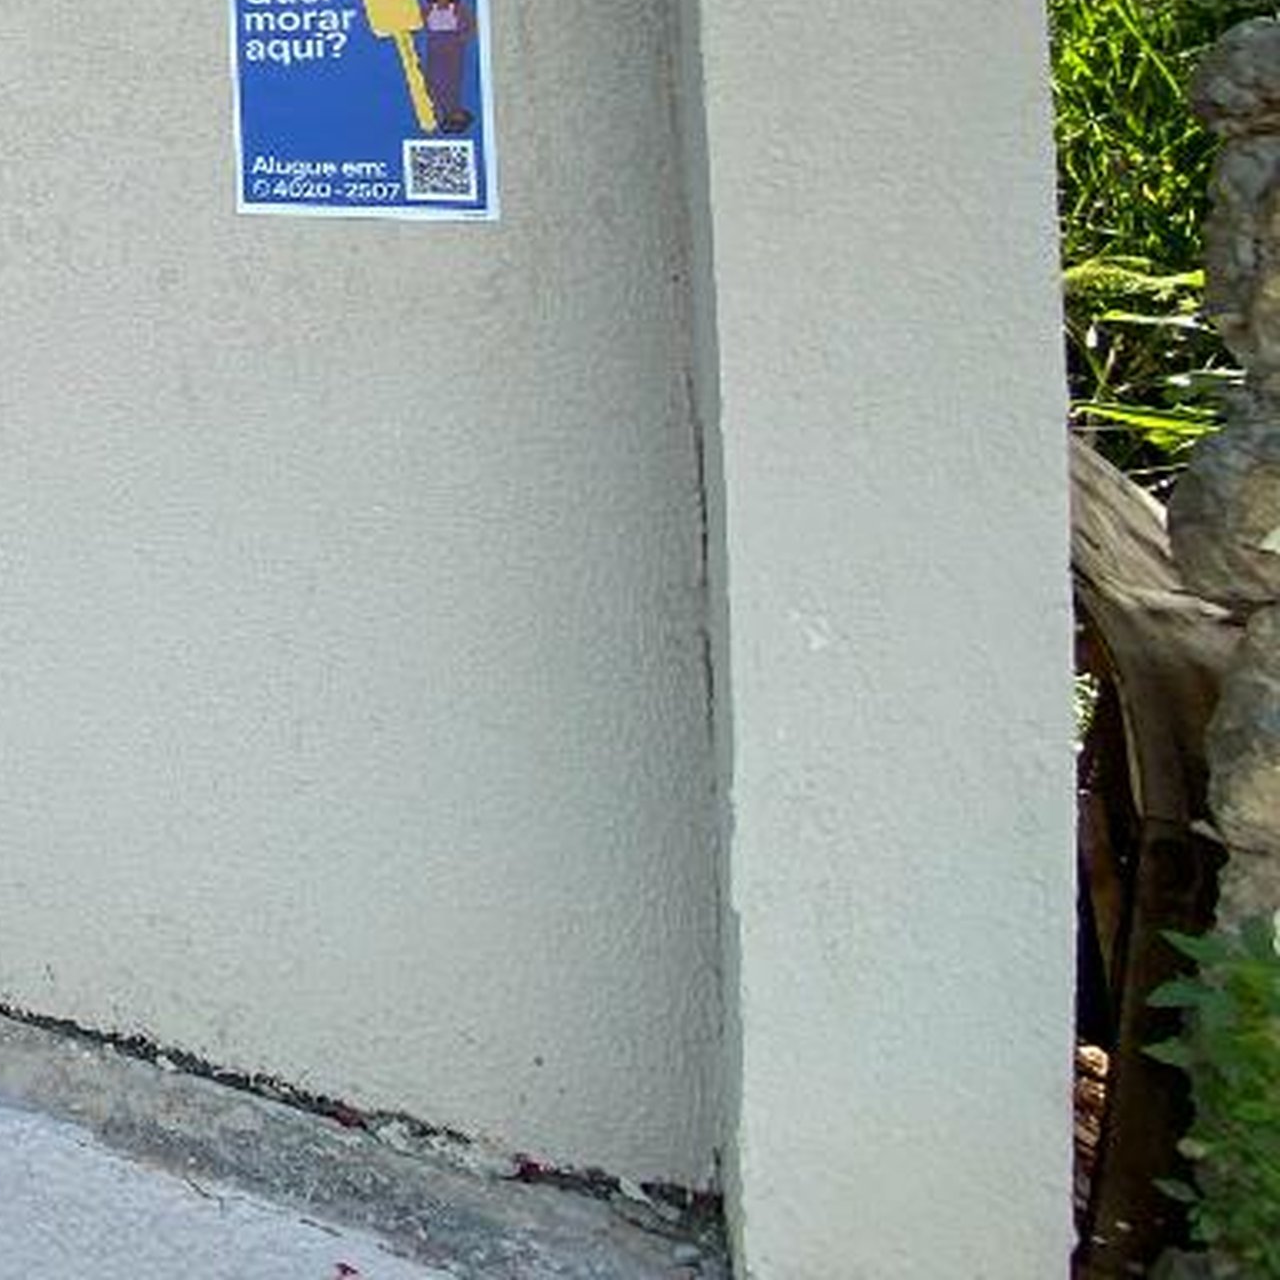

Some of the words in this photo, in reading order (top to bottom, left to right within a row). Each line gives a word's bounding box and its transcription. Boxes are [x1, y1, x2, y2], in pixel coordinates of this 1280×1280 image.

[244, 9, 357, 32] morar
[245, 33, 348, 65] aqui?
[252, 155, 338, 181] Alugue
[341, 162, 388, 178] em:
[272, 178, 333, 199] 4020
